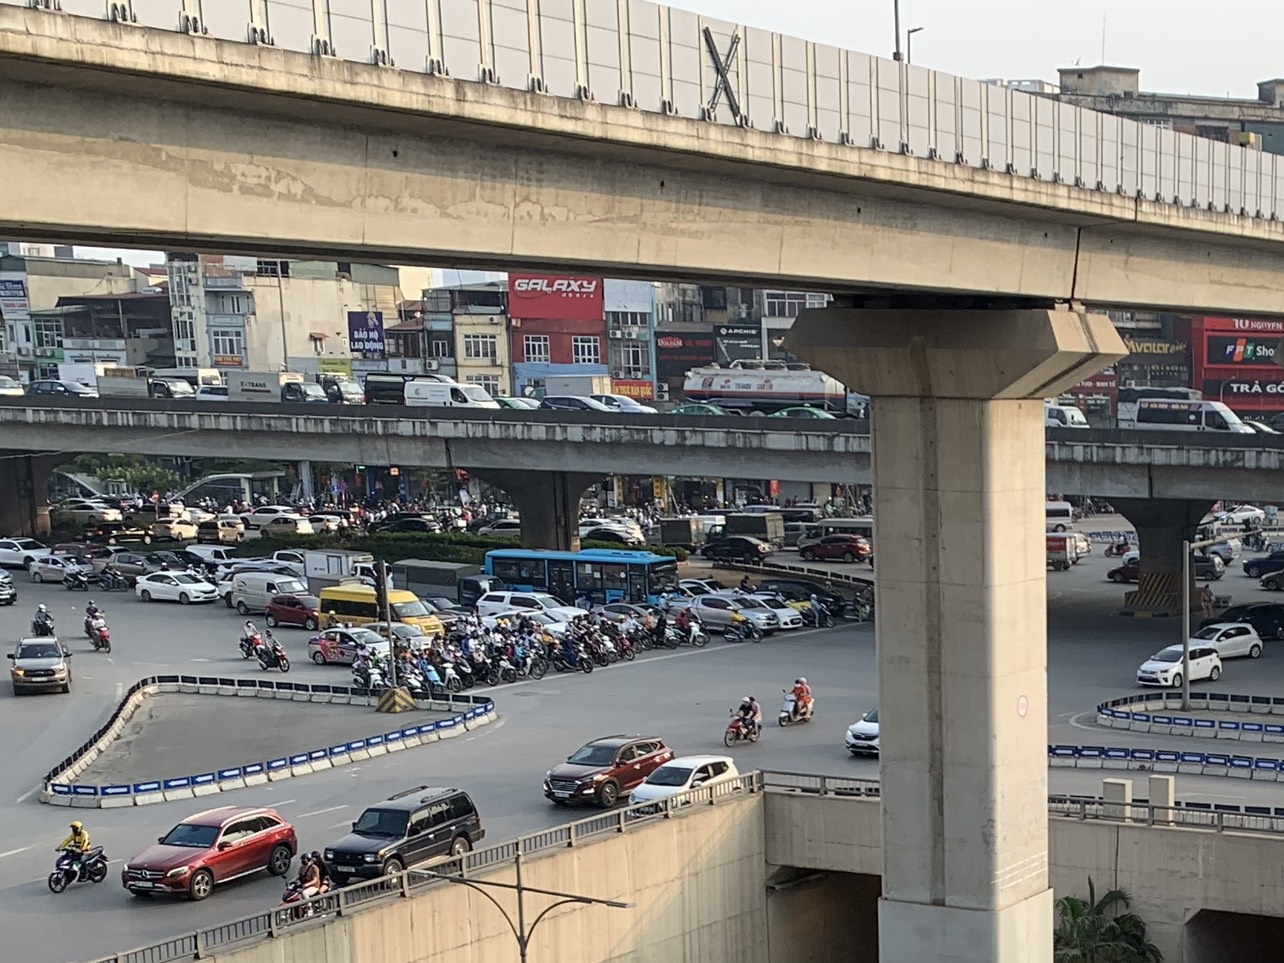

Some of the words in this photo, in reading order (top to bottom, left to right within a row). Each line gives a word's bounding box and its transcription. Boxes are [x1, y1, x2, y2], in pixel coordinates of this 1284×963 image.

[515, 279, 597, 292] GALAXY
[1256, 345, 1275, 357] Sho
[1230, 381, 1263, 393] TRẢ
